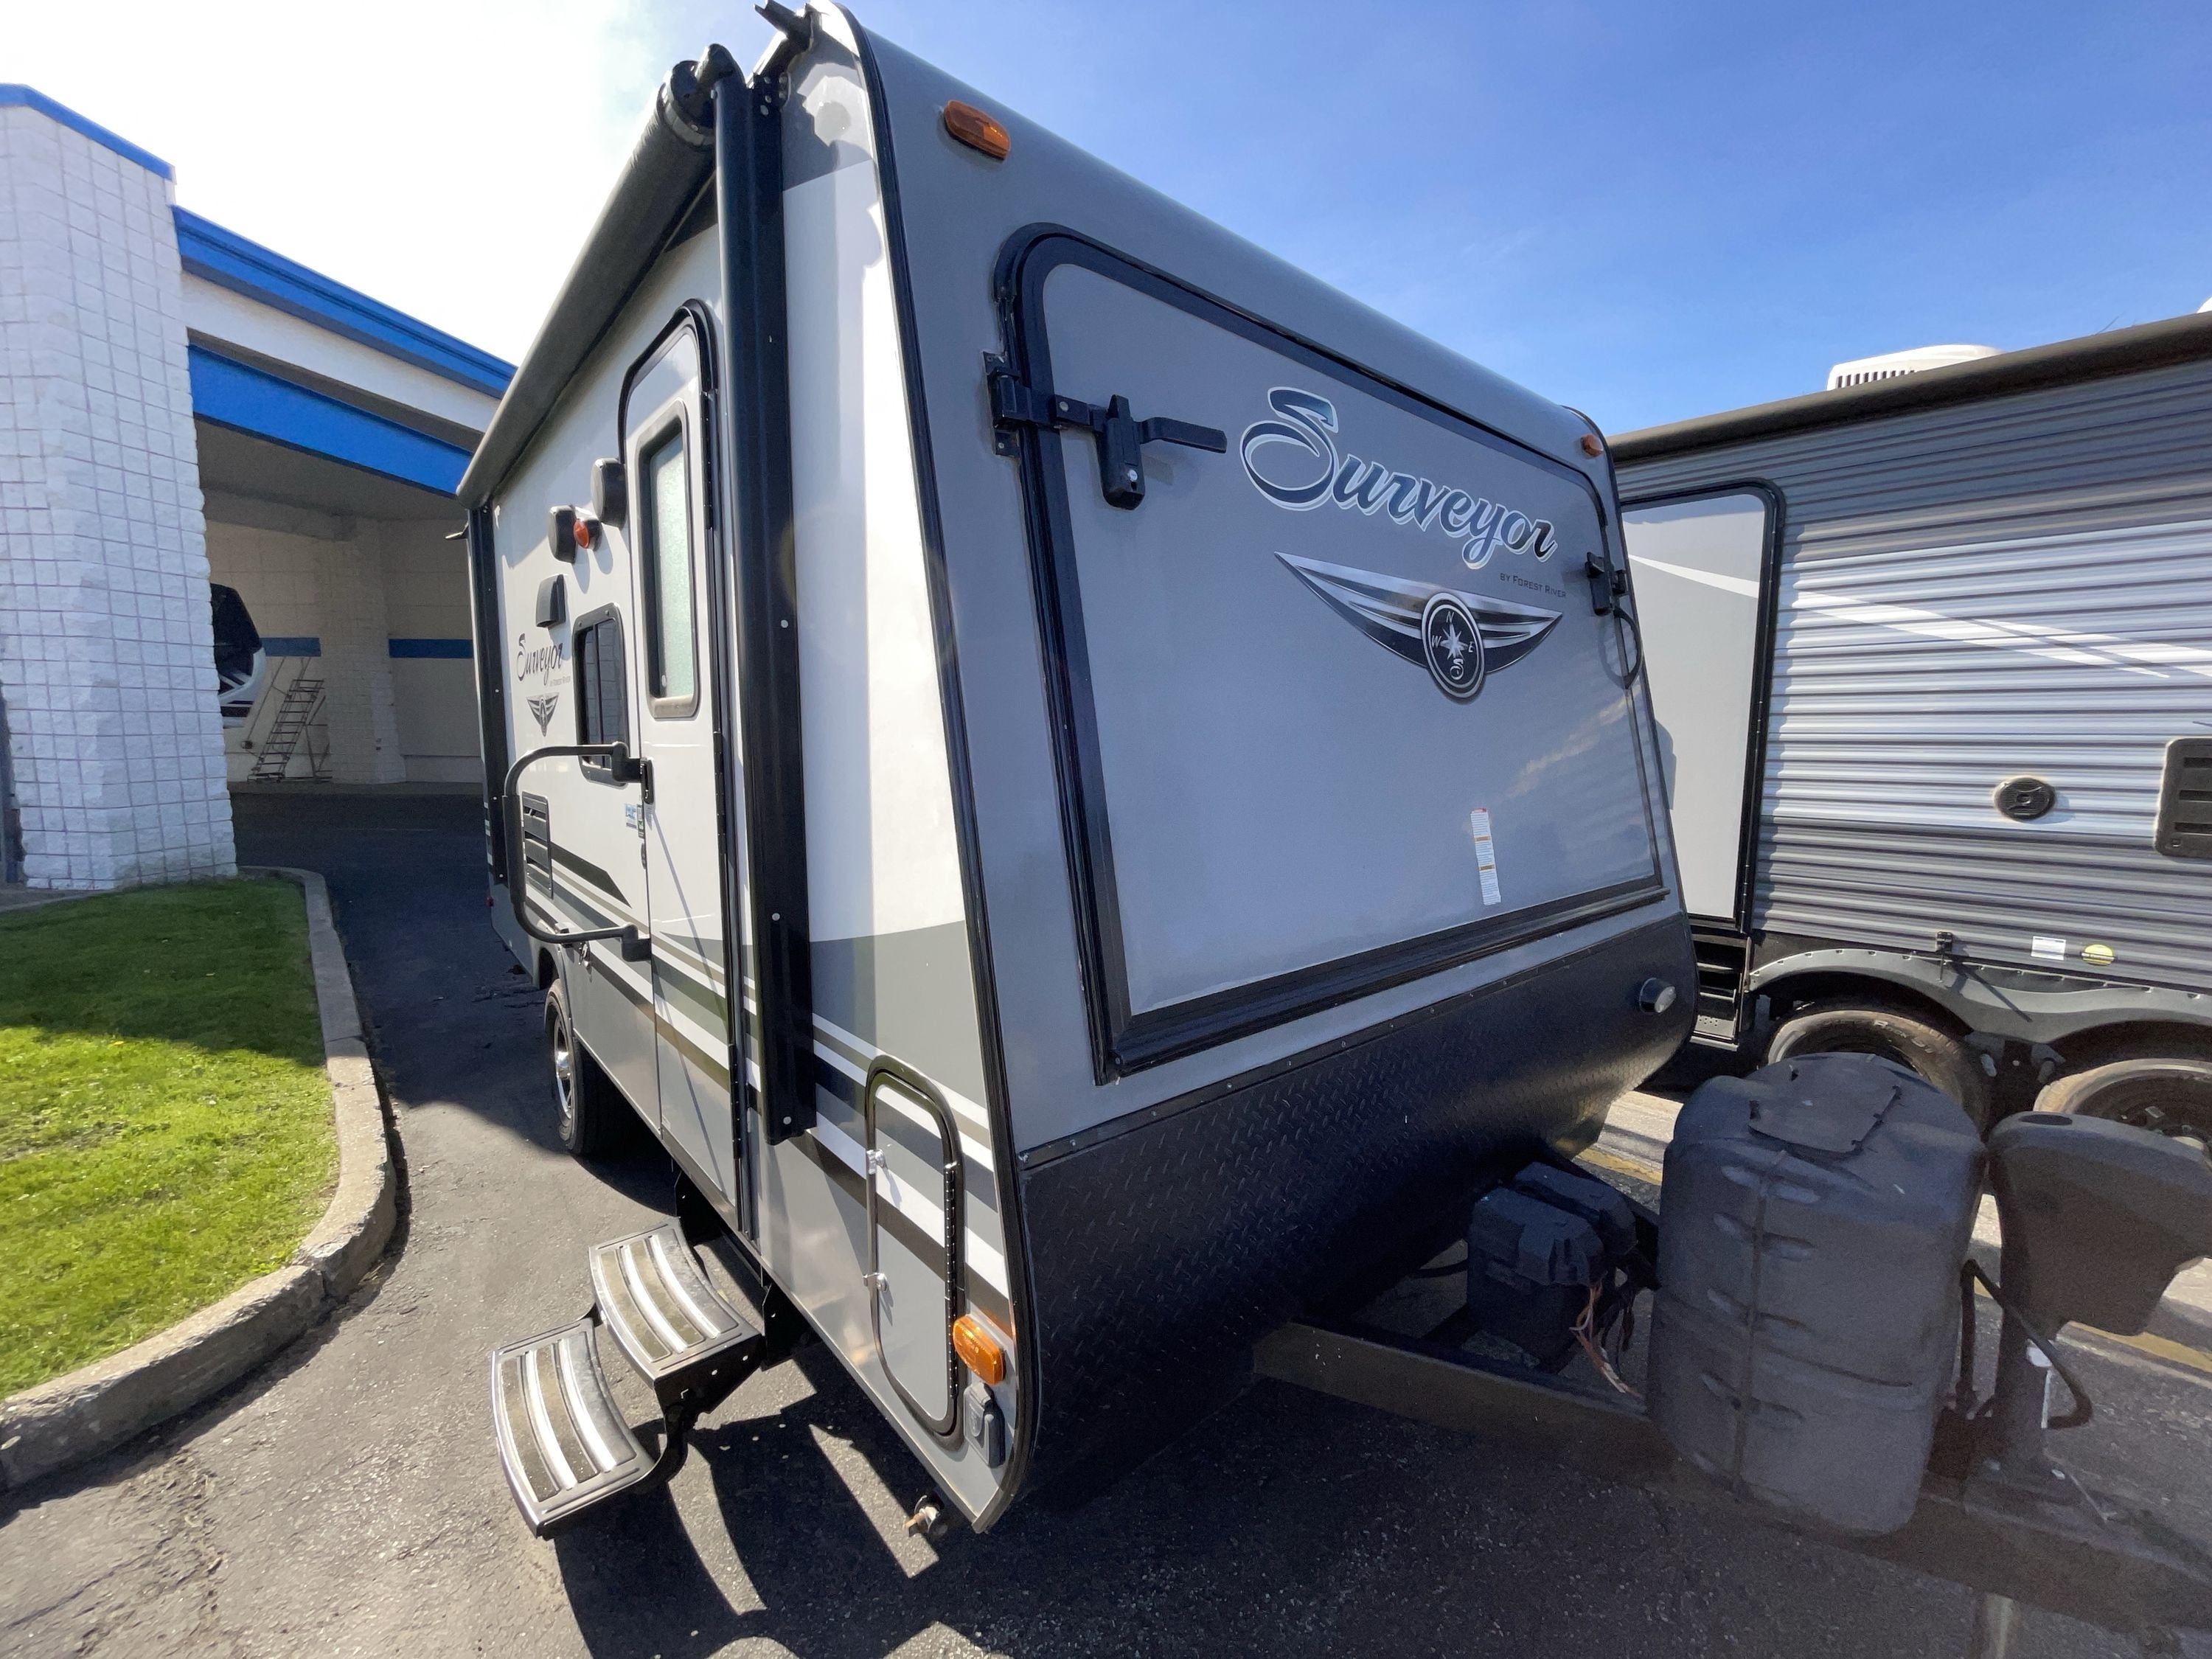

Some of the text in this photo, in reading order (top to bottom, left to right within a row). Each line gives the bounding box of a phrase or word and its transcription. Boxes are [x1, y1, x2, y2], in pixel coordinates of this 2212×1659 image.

[1239, 386, 1558, 570] Surveyor
[1500, 572, 1567, 598] BY FOREST RIVER
[1446, 611, 1455, 623] N
[1431, 635, 1475, 653] W E
[517, 633, 563, 686] Surveyor
[1450, 658, 1464, 680] S
